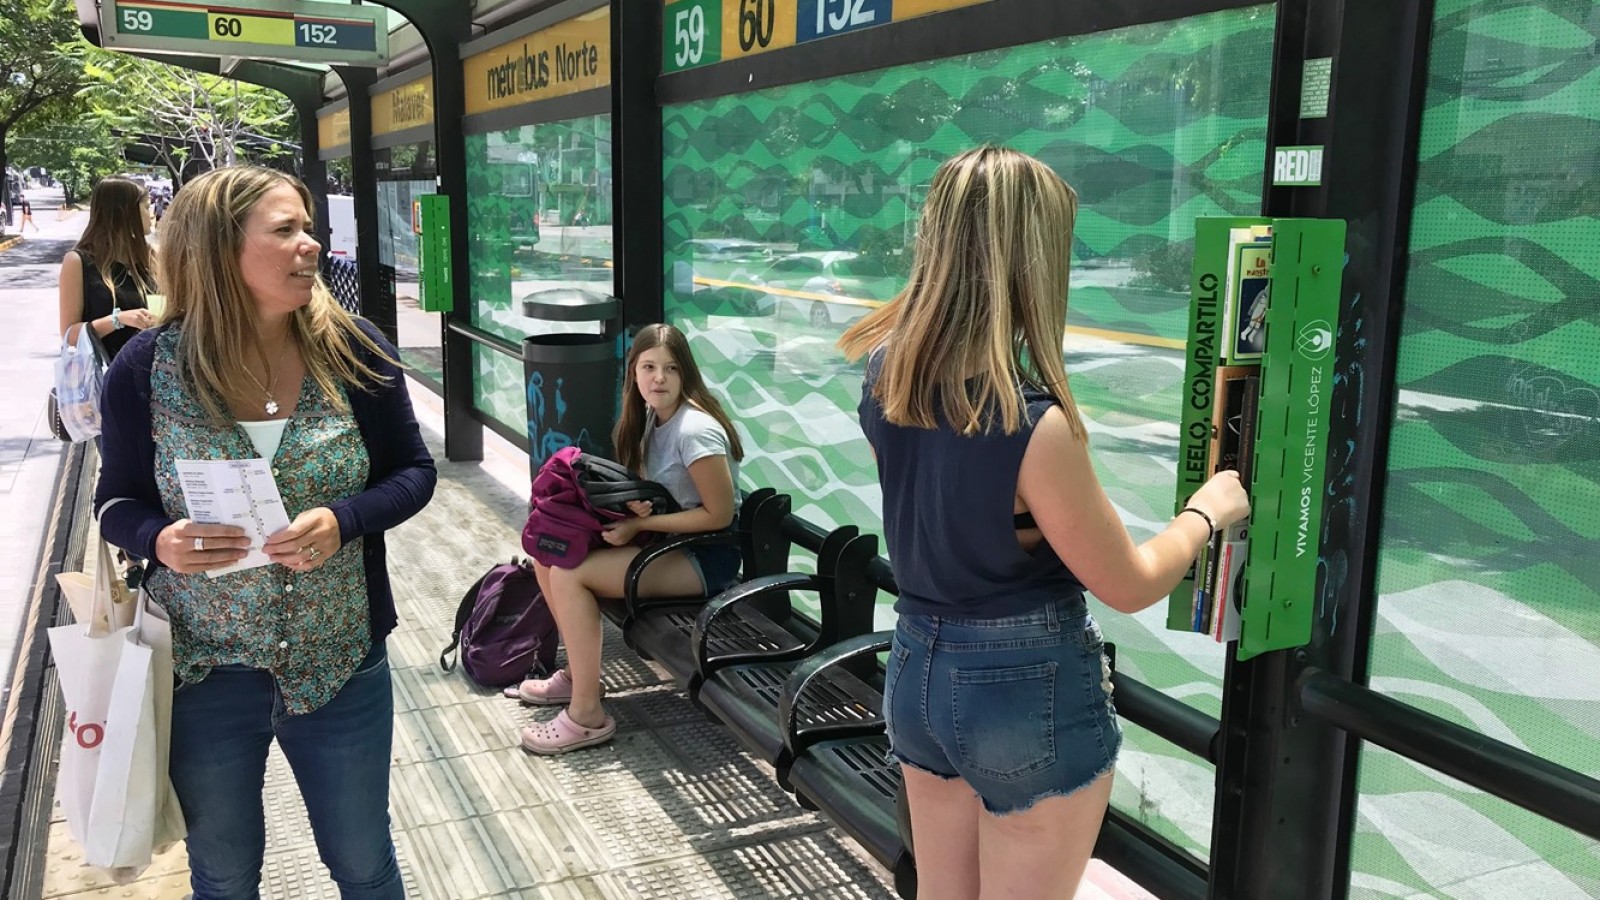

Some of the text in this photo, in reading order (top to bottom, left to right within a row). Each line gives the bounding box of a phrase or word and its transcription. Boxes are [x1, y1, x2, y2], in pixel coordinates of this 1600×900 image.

[124, 10, 153, 31] 59
[214, 17, 242, 37] 60
[299, 24, 337, 45] 152
[675, 5, 704, 67] 59
[739, 0, 774, 52] 60
[487, 40, 598, 100] metrobus Norte
[1274, 149, 1309, 182] RED
[1191, 273, 1219, 411] COMPARTILO
[1184, 417, 1211, 484] LEELO,
[1295, 366, 1322, 558] VIVAMOS VICENTE LÓPEZ
